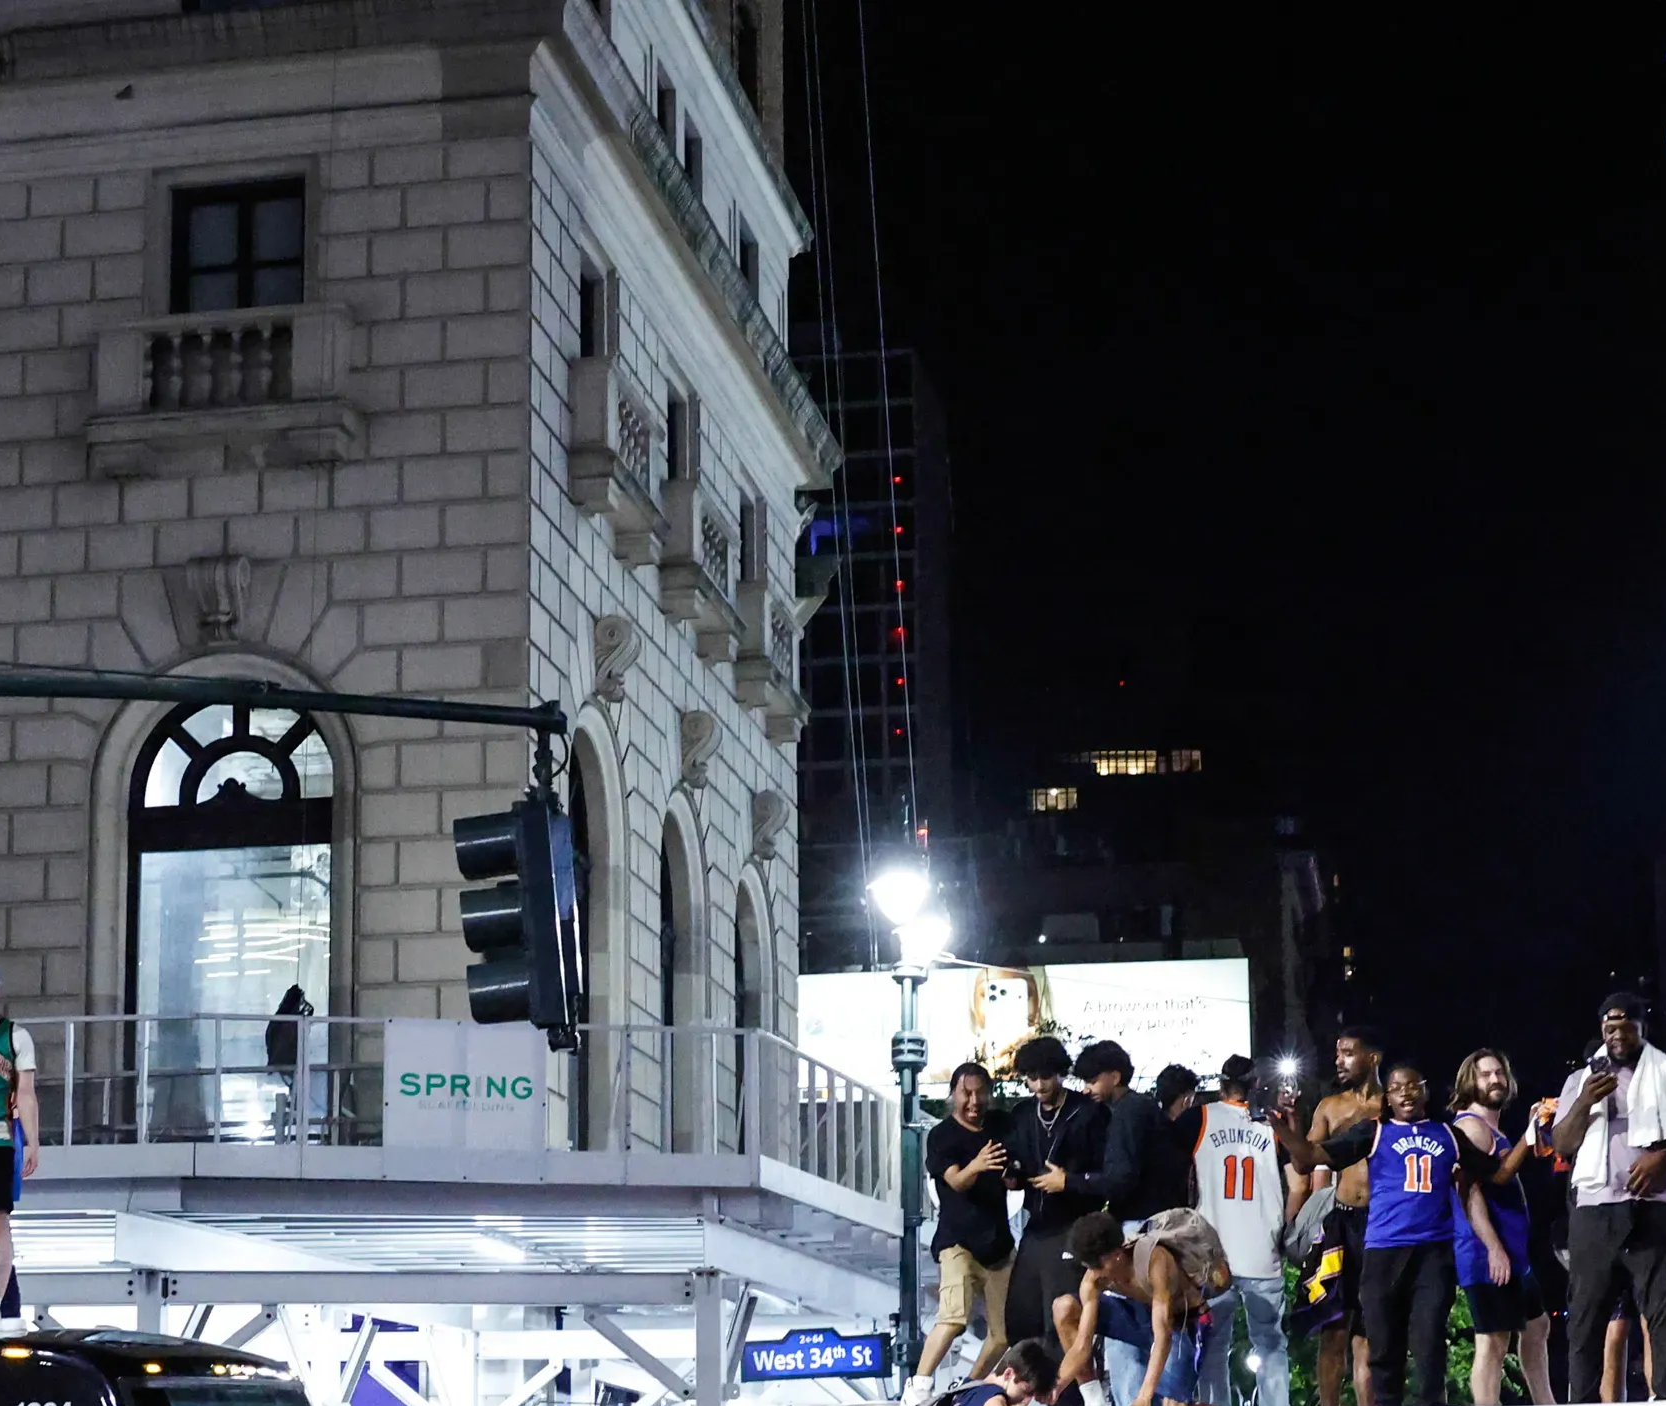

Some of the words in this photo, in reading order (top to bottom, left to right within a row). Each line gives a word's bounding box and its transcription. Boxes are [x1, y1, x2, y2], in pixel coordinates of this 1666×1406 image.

[399, 1072, 533, 1100] SPRING
[1209, 1127, 1272, 1153] BRUNSON
[1392, 1135, 1446, 1158] BRUNSON
[1223, 1154, 1254, 1201] 11
[1403, 1153, 1432, 1193] 11
[753, 1349, 805, 1371] West
[810, 1344, 846, 1369] 34th
[852, 1345, 873, 1367] St
